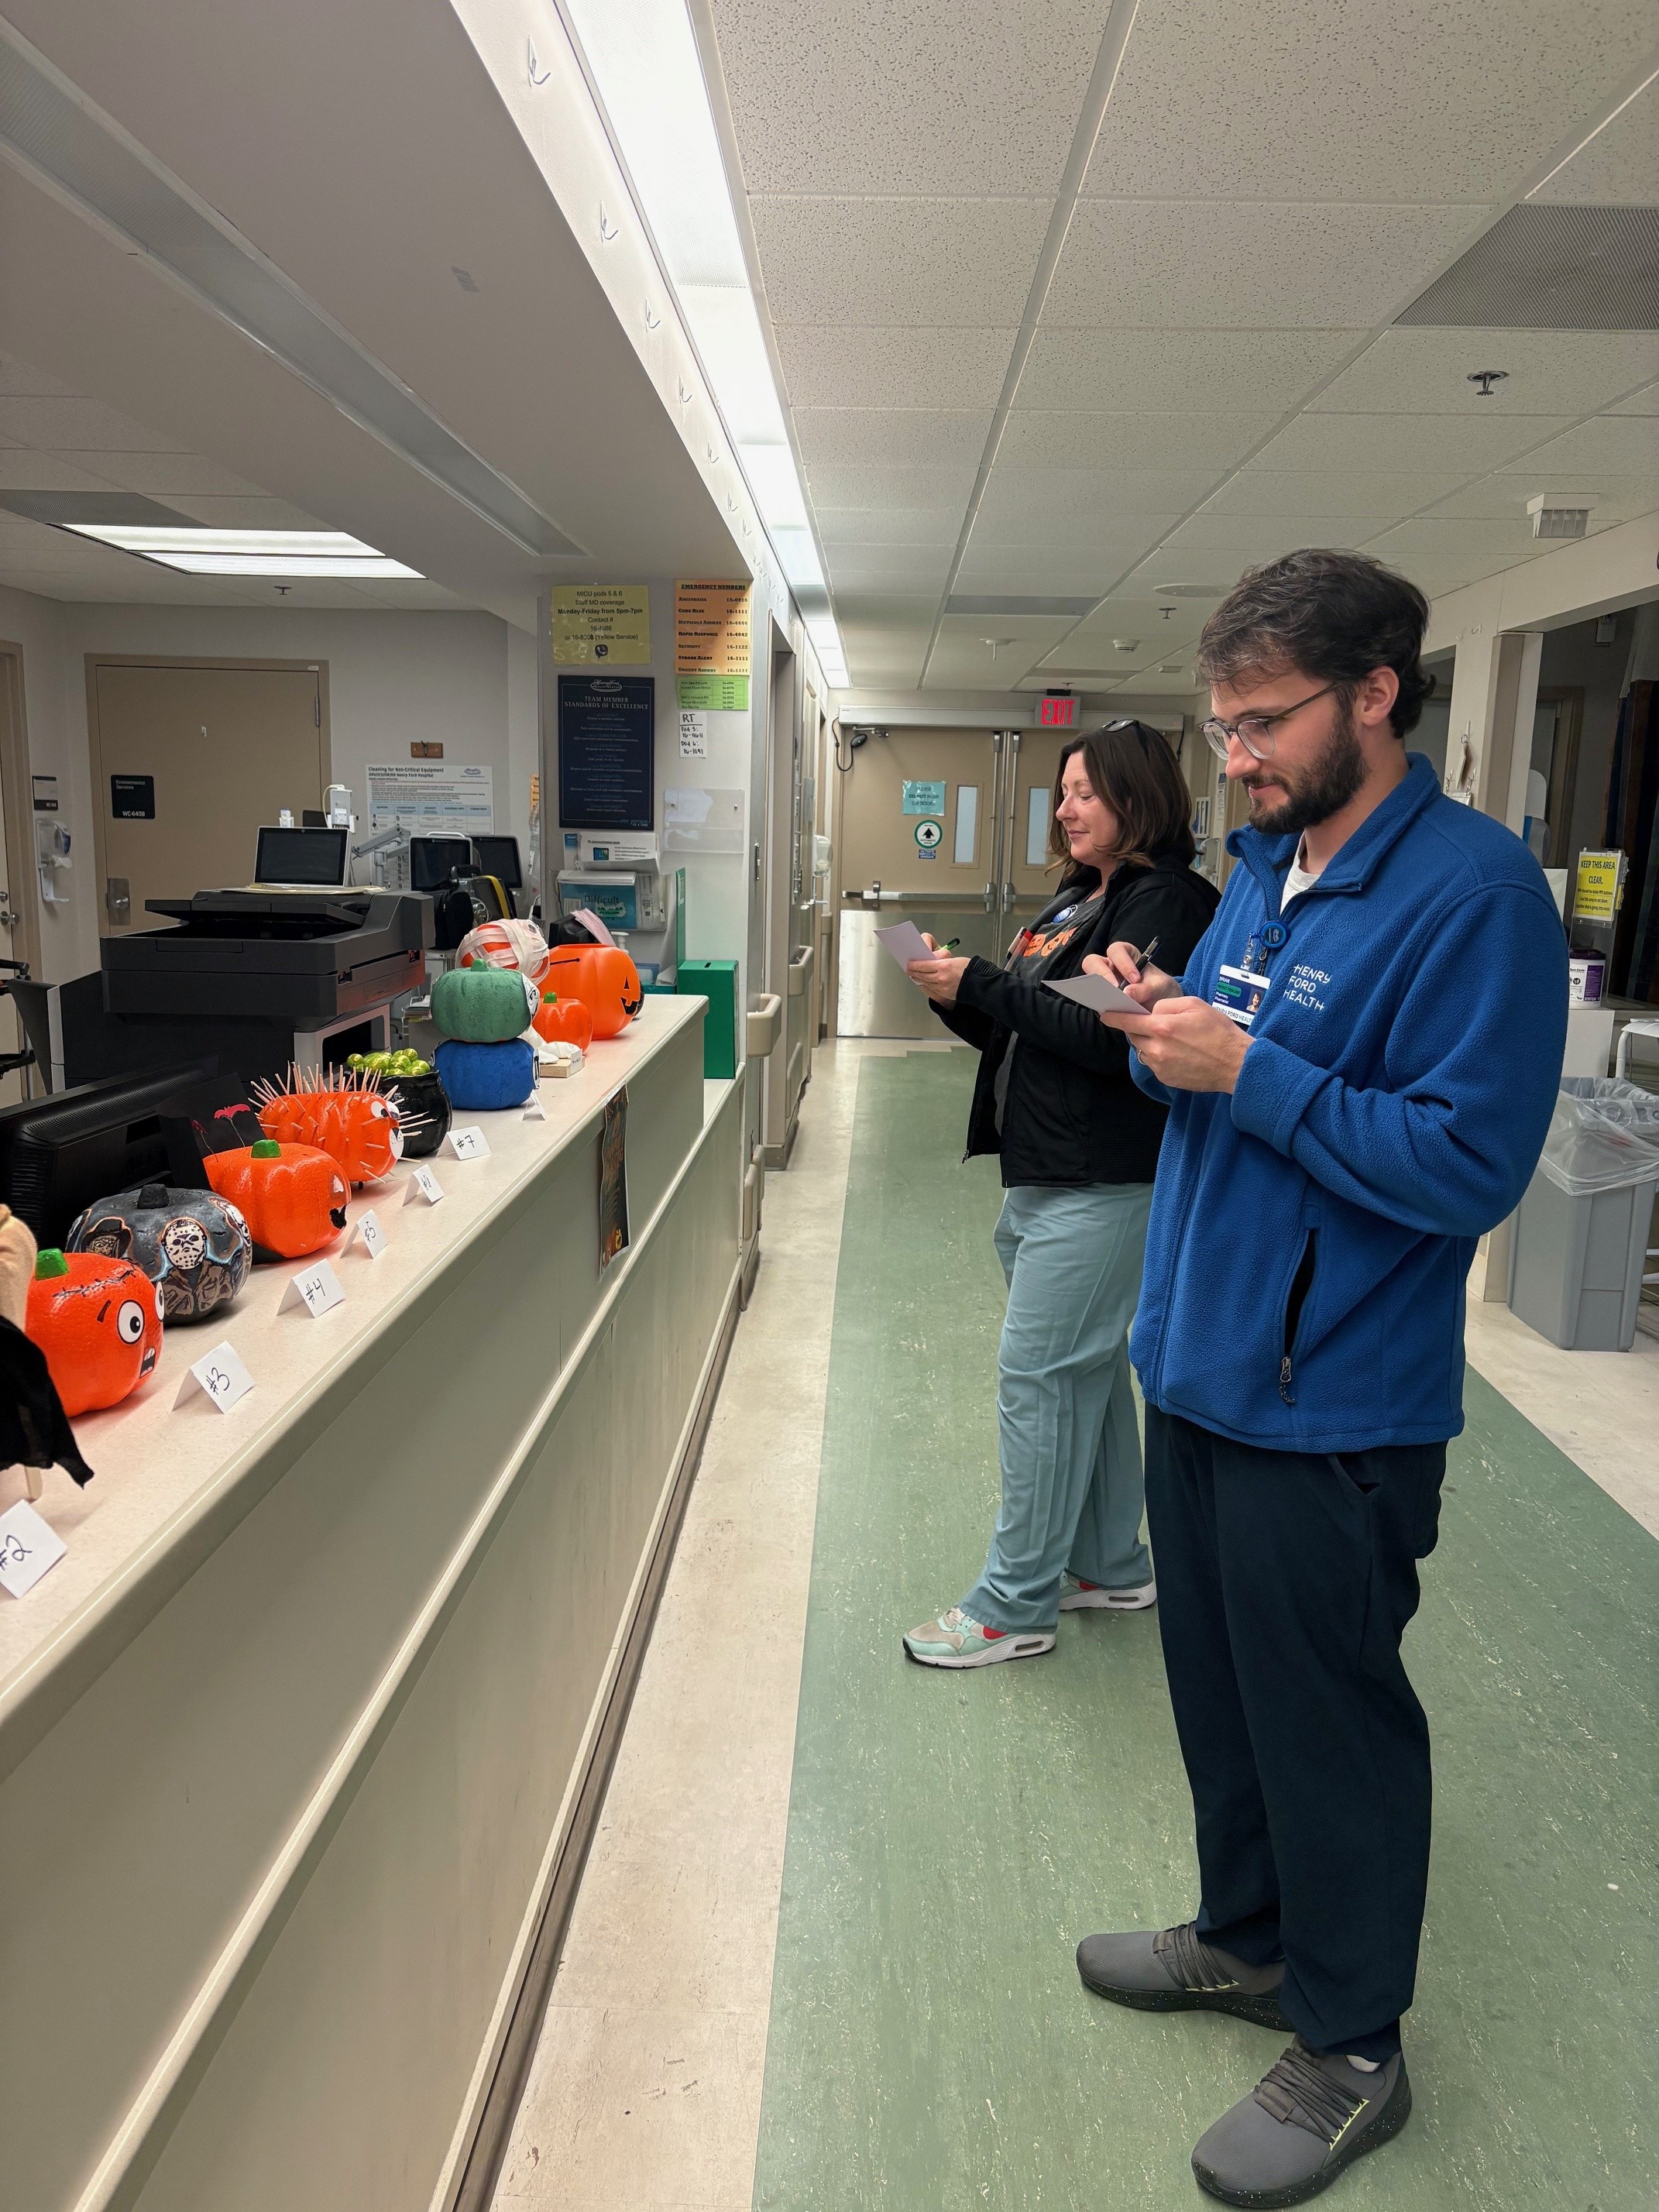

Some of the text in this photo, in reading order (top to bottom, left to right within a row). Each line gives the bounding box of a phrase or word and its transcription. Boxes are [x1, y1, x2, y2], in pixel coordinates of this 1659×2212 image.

[682, 713, 696, 723] RT
[1042, 699, 1075, 726] EXIT
[584, 895, 620, 905] Difficult
[1293, 964, 1332, 983] HENRY
[1288, 976, 1316, 992] FORD
[1283, 989, 1324, 1011] HEALTH
[456, 1135, 475, 1150] #7
[365, 1221, 376, 1242] #5
[306, 1278, 325, 1304] #4
[205, 1367, 230, 1395] #3
